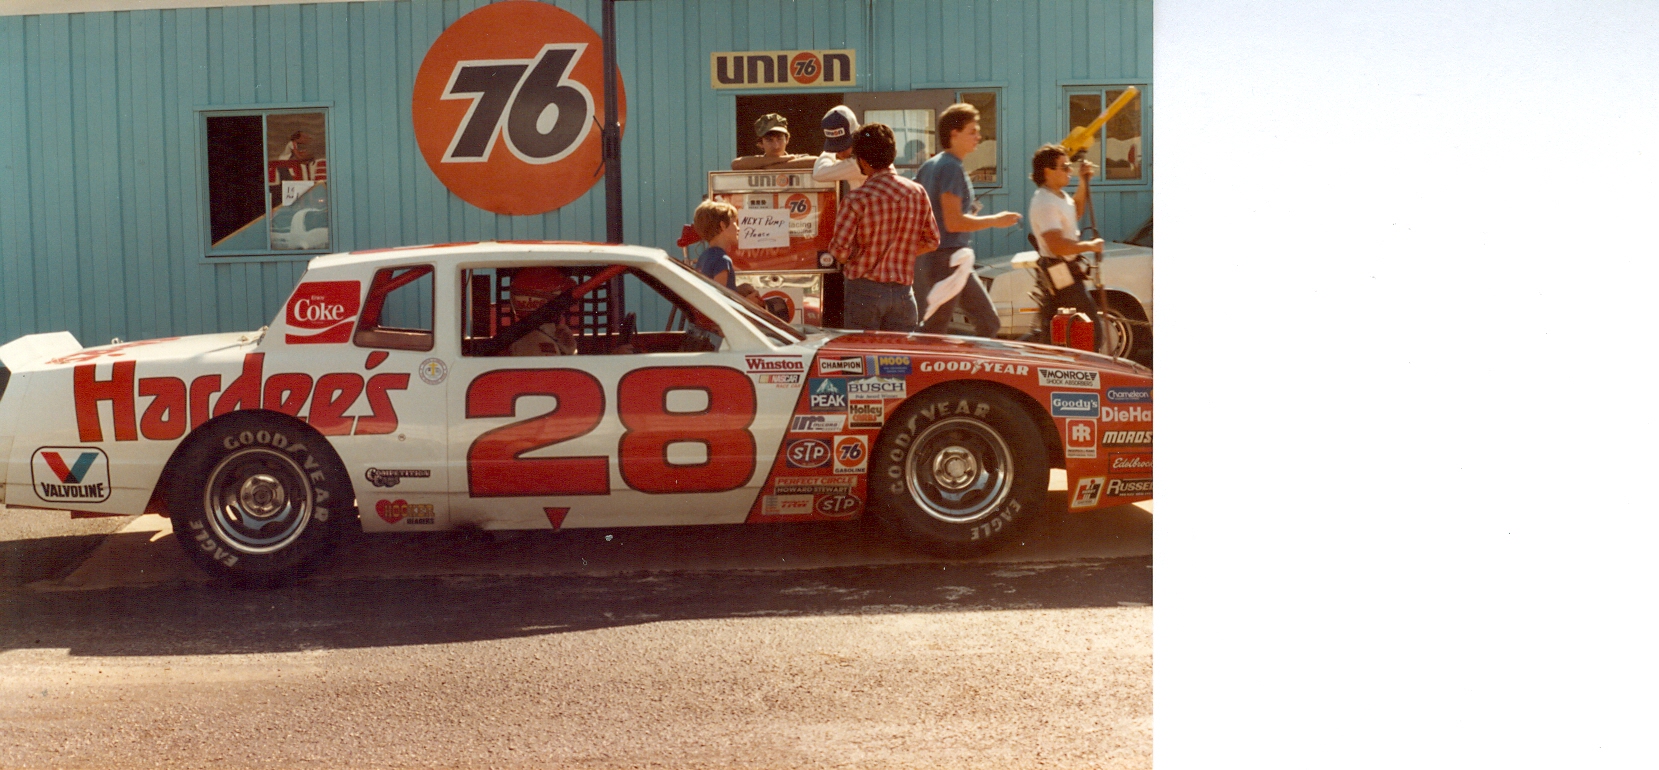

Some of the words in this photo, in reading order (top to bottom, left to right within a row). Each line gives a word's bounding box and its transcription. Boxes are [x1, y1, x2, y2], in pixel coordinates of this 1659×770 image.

[793, 58, 816, 76] 76
[440, 43, 595, 165] 76
[789, 200, 807, 213] 76
[293, 299, 344, 321] Coke
[745, 358, 804, 370] Winston
[821, 361, 861, 369] CHAMPION
[880, 357, 910, 366] MOOG
[771, 375, 799, 383] NASCAR
[1046, 369, 1092, 381] MONROE
[848, 383, 904, 393] BUSCH
[1107, 389, 1149, 400] Chameleon
[73, 351, 410, 443] Hardee's
[810, 395, 846, 407] PEAK
[849, 404, 883, 417] Holley
[1053, 398, 1098, 411] Goody's
[465, 365, 757, 498] 28
[793, 442, 824, 461] STP
[840, 443, 862, 460] 76
[777, 477, 818, 486] PERFECT
[820, 476, 854, 484] CIRCLE
[41, 482, 104, 498] VALVOLINE
[822, 495, 855, 511] STP
[971, 498, 1022, 540] EAGLE
[188, 520, 239, 567] EAGLE
